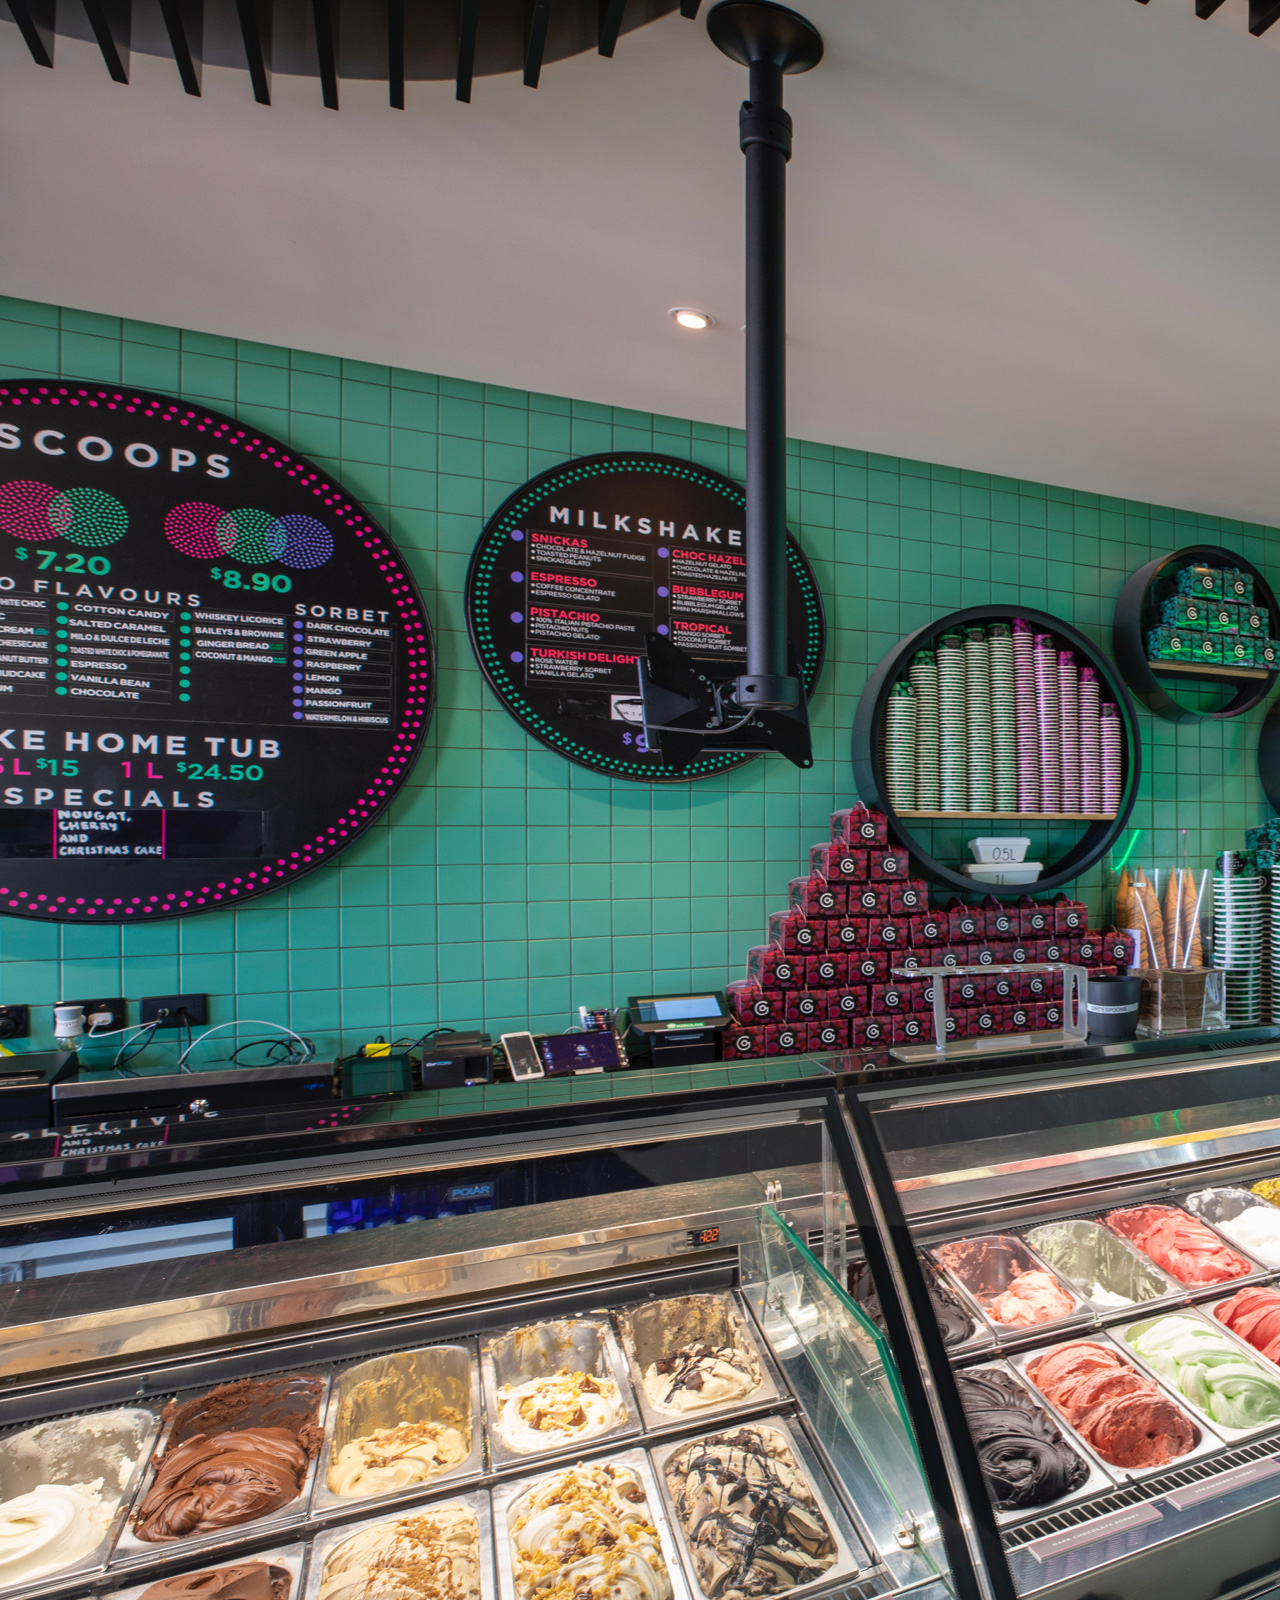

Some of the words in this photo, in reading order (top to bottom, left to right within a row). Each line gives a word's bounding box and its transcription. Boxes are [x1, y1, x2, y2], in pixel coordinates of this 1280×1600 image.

[0, 423, 231, 478] SCOOPS
[531, 533, 588, 548] SNICKAS
[536, 543, 579, 553] CHOCOLATE
[586, 549, 622, 559] HAZELNUT
[536, 550, 568, 558] TOASTED
[569, 554, 601, 562] PEANUTS
[672, 549, 706, 560] CHOC
[15, 547, 111, 576] $7.20
[536, 556, 565, 564] SNICKAS
[565, 559, 591, 567] GELATO
[676, 559, 707, 567] HAZELNUT
[676, 565, 713, 573] CHOCOLATE
[211, 567, 292, 593] $8.90
[531, 572, 597, 587] ESPRESSO
[703, 573, 737, 581] HAZELNUTS
[34, 580, 201, 607] FLAVOURS
[535, 583, 564, 591] COFFEE
[565, 586, 616, 597] CONCENTRATE
[535, 589, 572, 599] ESPRESSO
[573, 594, 600, 602] GELATO
[673, 585, 743, 600] BUBBLEGUM
[677, 594, 717, 603] STRAWBERRY
[677, 600, 715, 609] BUBBLEGUM
[74, 604, 125, 615] COTTON
[127, 609, 169, 619] CANDY
[295, 604, 389, 622] SORBET
[530, 607, 600, 622] PISTACHIO
[691, 608, 744, 618] MARSHMALLOWS
[195, 612, 239, 621] WHISKEY
[240, 616, 284, 625] LICORICE
[69, 619, 112, 628] SALTED
[114, 622, 166, 633] CARAMEL
[306, 622, 333, 631] DARK
[334, 625, 390, 636] CHOCOLATE
[535, 623, 570, 631] PISTACHIO
[581, 621, 614, 630] PISTACHIO
[673, 621, 732, 634] TROPICAL
[195, 627, 233, 635] BAILEYS
[242, 630, 285, 638] BROWNIE
[535, 629, 572, 638] PISTACHIO
[196, 640, 234, 648] GINGER
[307, 636, 372, 647] STRAWBERRY
[678, 642, 722, 650] PASSIONFRUIT
[195, 651, 236, 660] COCONUT
[243, 655, 273, 663] MANGO
[305, 648, 337, 657] GREEN
[338, 651, 368, 660] APPLE
[530, 648, 586, 660] TURKISH
[70, 660, 128, 670] ESPRESSO
[306, 661, 362, 671] RASPBERRY
[535, 664, 583, 672] STRAWBERRY
[70, 674, 119, 685] VANILLA
[120, 679, 150, 688] BEAN
[305, 674, 339, 682] LEMON
[70, 688, 140, 699] CHOCOLATE
[306, 687, 343, 695] MANGO
[305, 700, 372, 709] PASSIONFRUIT
[65, 732, 187, 755] HOME
[204, 737, 281, 759] TUB
[36, 758, 79, 777] $15
[176, 762, 263, 781] $24.50
[4, 787, 215, 808] SPECIALS
[59, 821, 117, 832] CHERRY
[59, 834, 89, 843] AND
[59, 845, 129, 855] CHRISTMAS
[134, 846, 162, 855] CAKE
[60, 1142, 130, 1157] CHRISTMAS
[452, 1185, 490, 1198] POLAR
[1194, 1477, 1234, 1494] STRAWBERRY
[1234, 1468, 1257, 1480] SORBET
[1051, 1536, 1071, 1547] DARK
[1073, 1523, 1113, 1541] CHOCOLATE
[1114, 1513, 1140, 1525] SORBET
